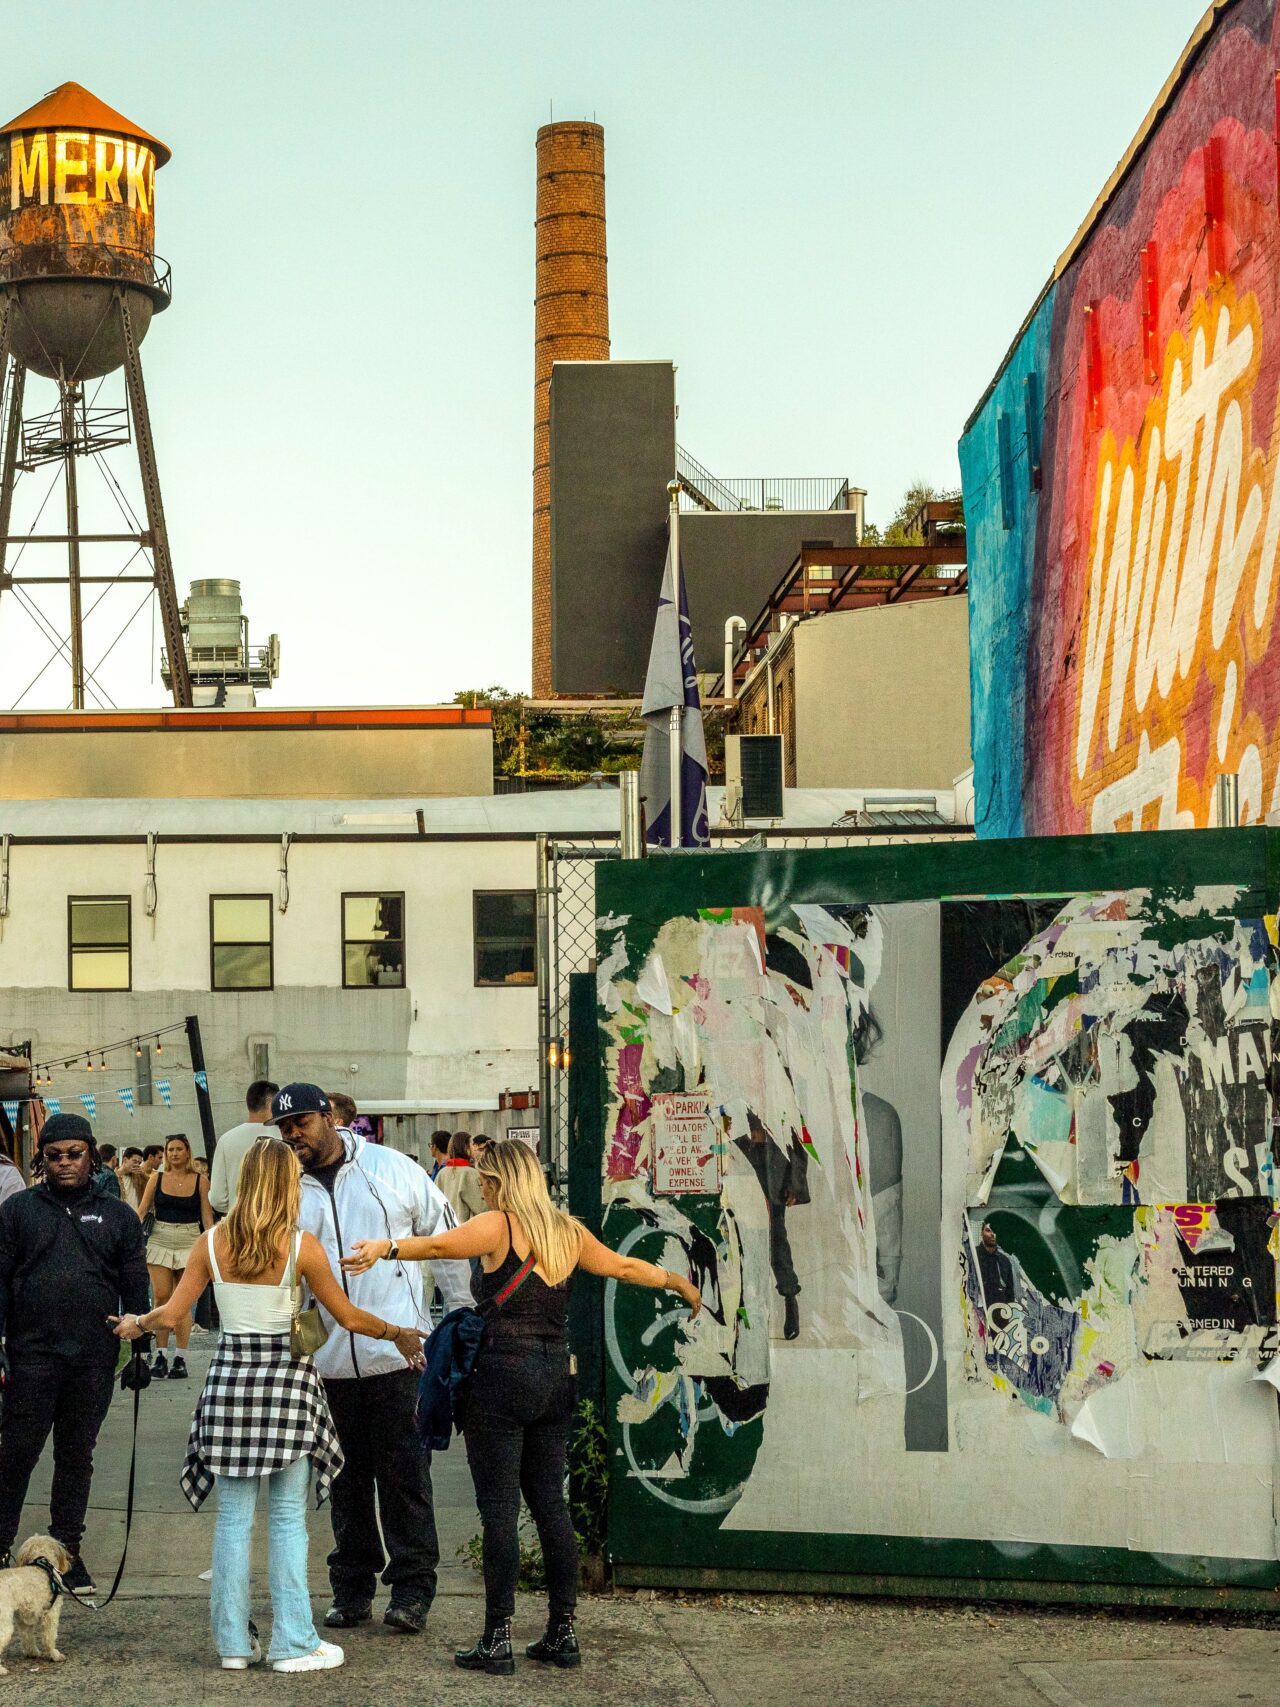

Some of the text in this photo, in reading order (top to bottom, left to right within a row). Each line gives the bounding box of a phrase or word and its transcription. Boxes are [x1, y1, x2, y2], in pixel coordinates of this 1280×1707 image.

[279, 1093, 293, 1111] NY
[676, 1101, 705, 1114] PARKI
[691, 1134, 703, 1143] BE
[669, 1178, 706, 1187] EXPENSE
[1223, 1319, 1235, 1328] IN
